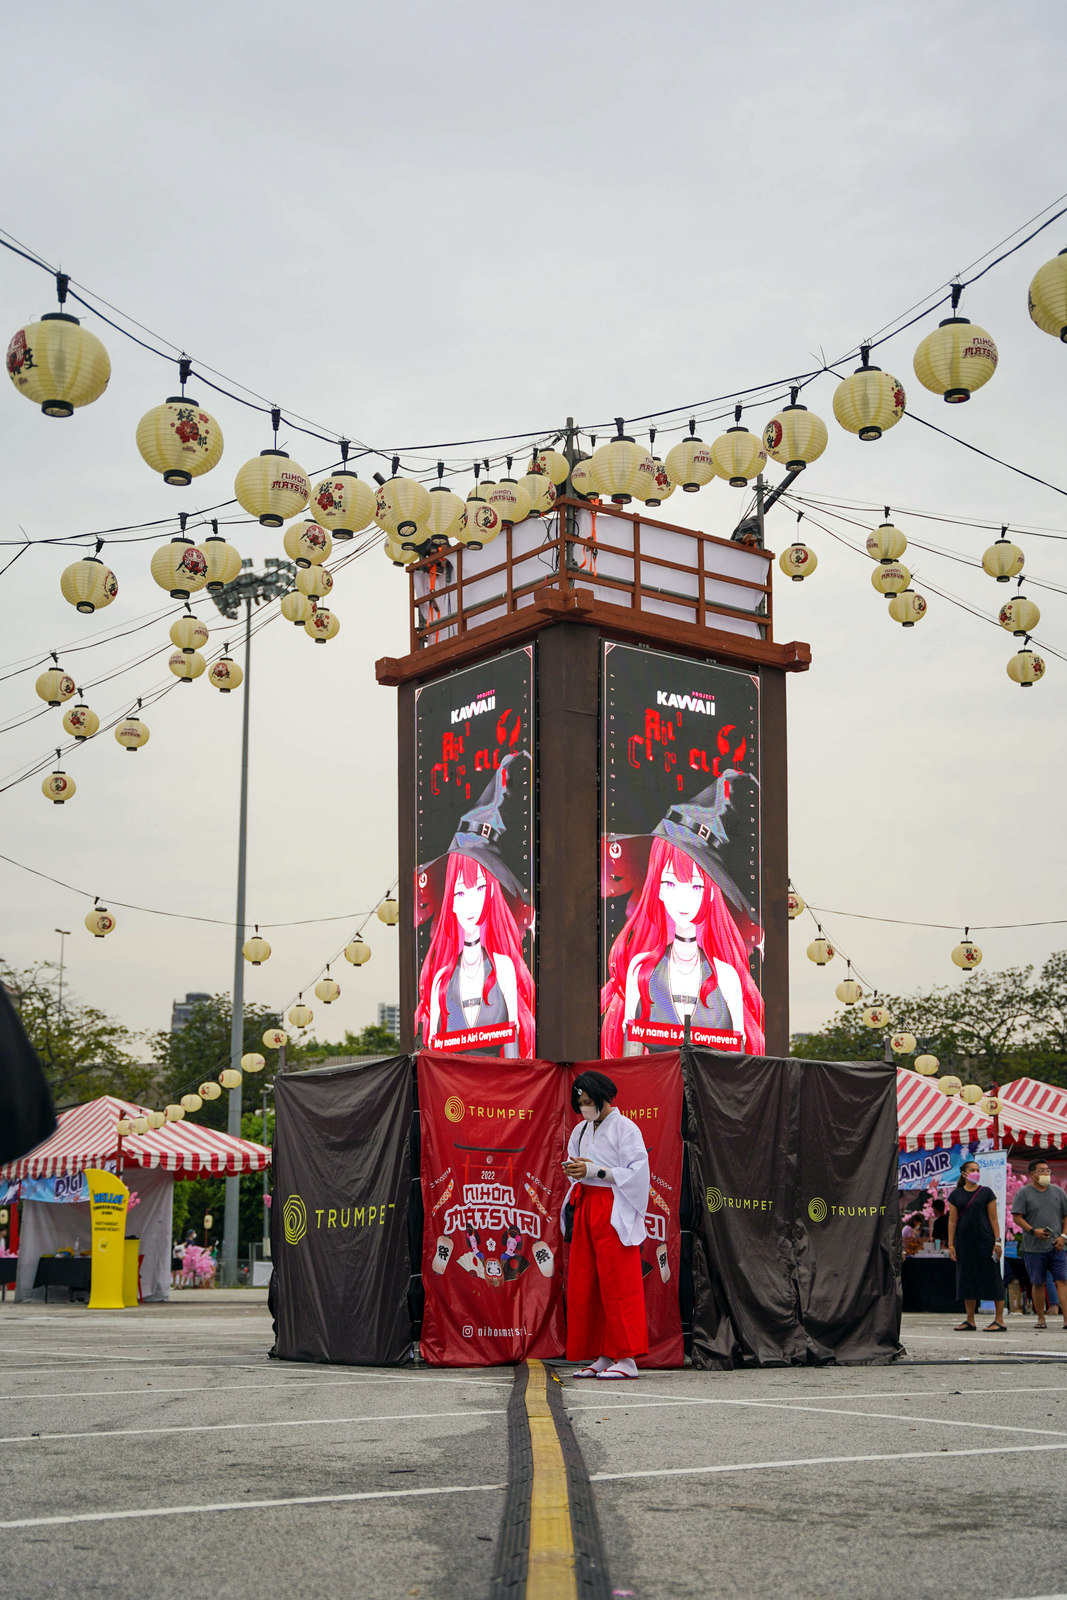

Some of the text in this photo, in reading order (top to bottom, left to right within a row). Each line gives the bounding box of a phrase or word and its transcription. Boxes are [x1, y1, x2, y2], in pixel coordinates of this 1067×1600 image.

[692, 456, 714, 465] MATS
[280, 472, 307, 487] NIHON
[271, 480, 309, 500] MATSUR
[476, 689, 496, 700] PROJECT
[691, 690, 716, 701] PROJECT
[450, 695, 496, 724] KAWAII
[656, 690, 716, 716] KAWAII
[434, 1039, 444, 1050] My
[444, 1037, 460, 1047] name
[461, 1035, 467, 1044] is
[467, 1032, 478, 1043] Airi
[631, 1025, 738, 1045] My name is Ai Gwynevere
[469, 1105, 534, 1120] TRUMPET
[924, 1152, 951, 1177] AIR
[481, 1171, 495, 1180] 2022
[463, 1183, 515, 1206] NIHON
[722, 1196, 774, 1211] TRUMPET
[831, 1205, 887, 1217] TRUMPT
[444, 1203, 541, 1238] MATSURI
[477, 1326, 533, 1337] nihonmatsri_
